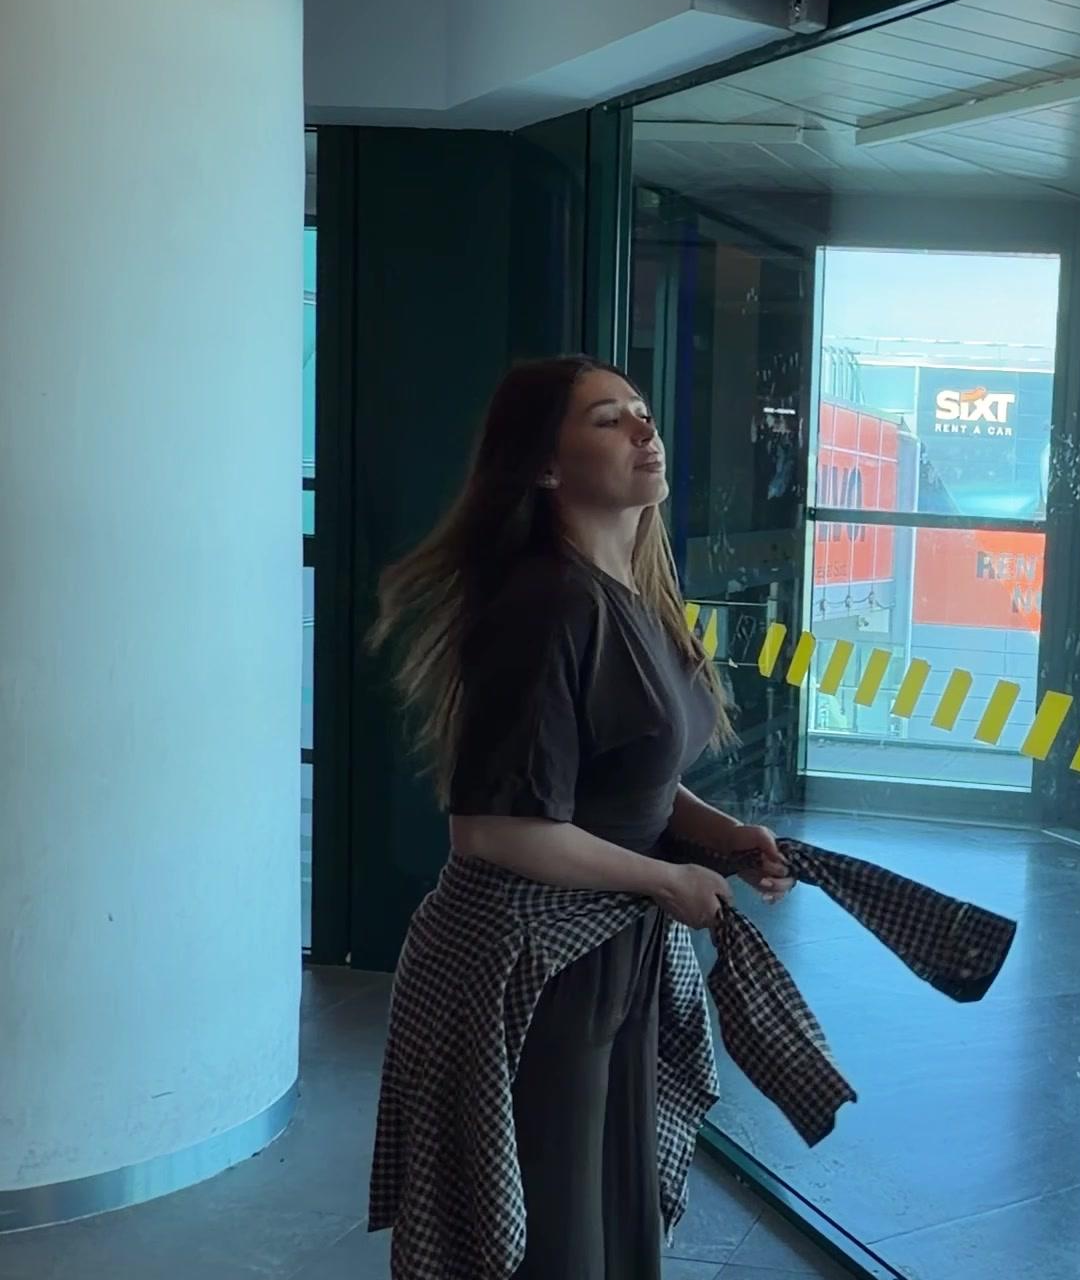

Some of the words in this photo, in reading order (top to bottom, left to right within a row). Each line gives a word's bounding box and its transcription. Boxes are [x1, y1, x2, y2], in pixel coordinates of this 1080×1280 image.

[935, 387, 1016, 423] SIXT
[935, 423, 967, 433] RENT
[973, 425, 981, 434] A
[987, 426, 1012, 436] CAR
